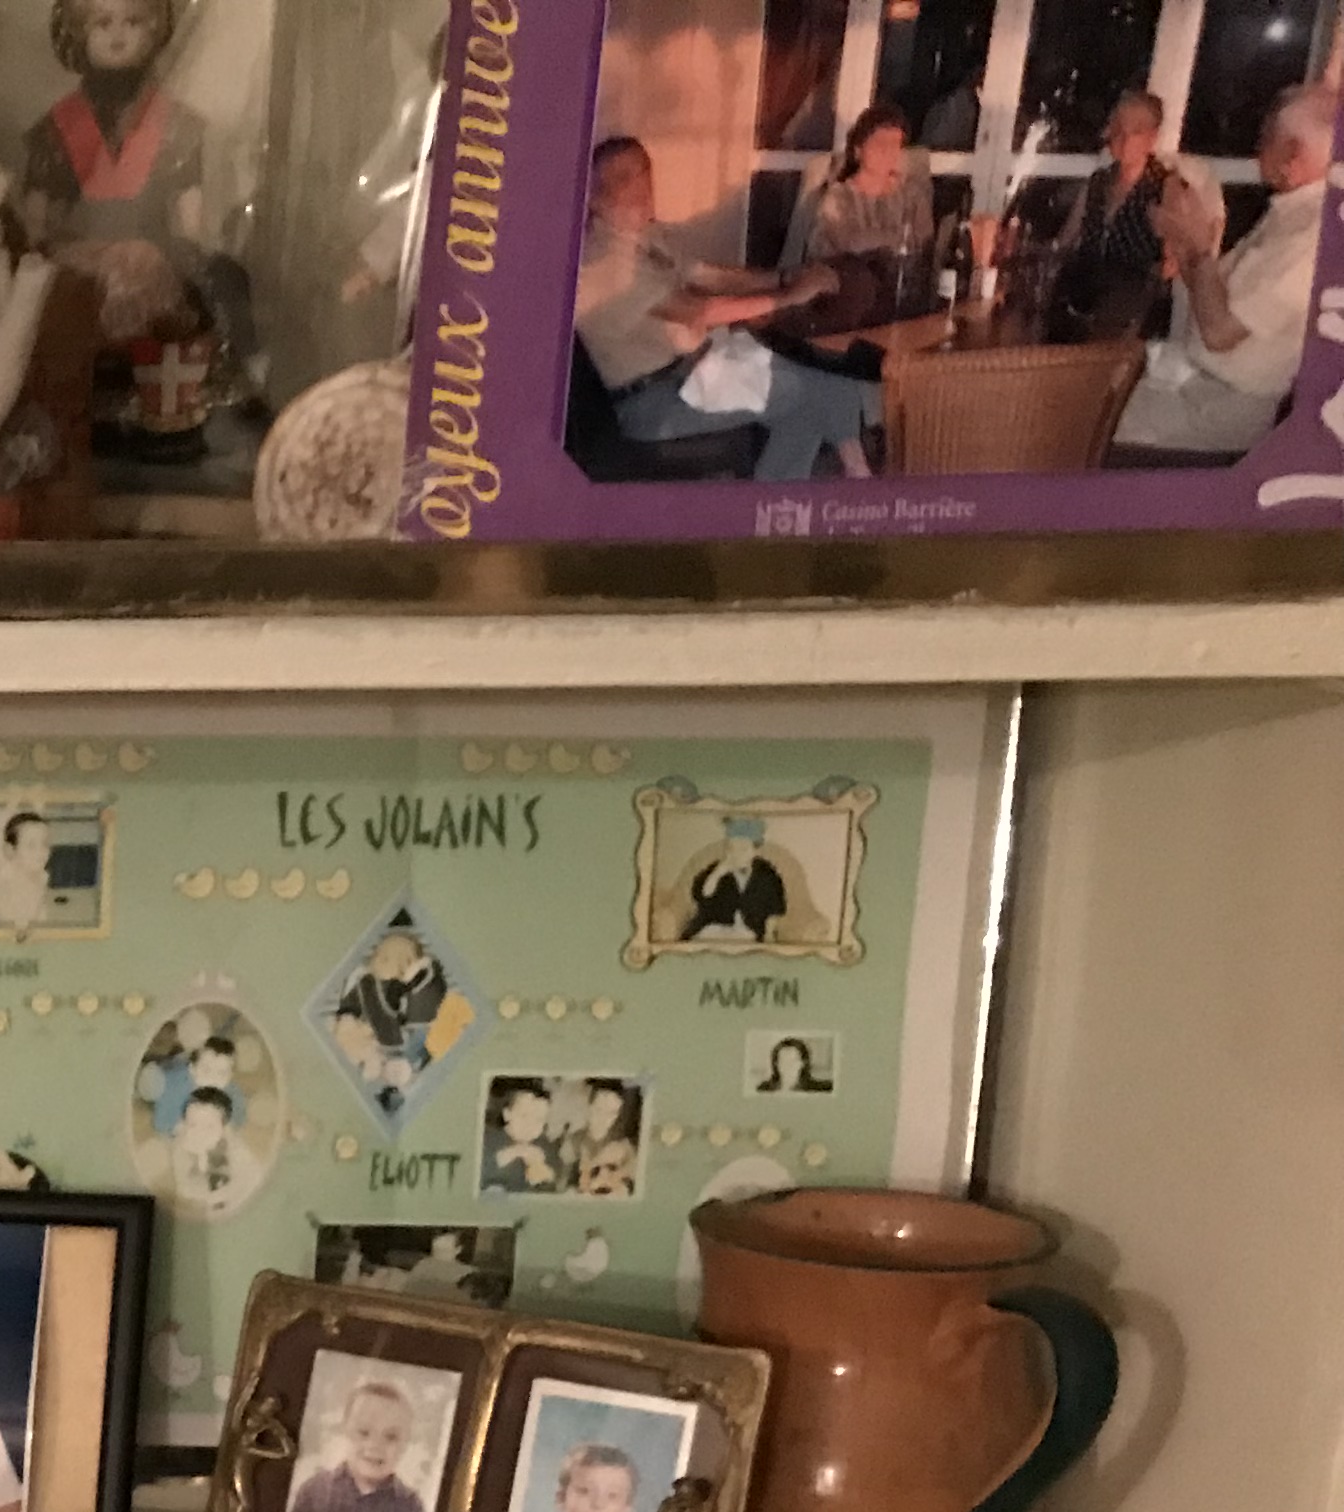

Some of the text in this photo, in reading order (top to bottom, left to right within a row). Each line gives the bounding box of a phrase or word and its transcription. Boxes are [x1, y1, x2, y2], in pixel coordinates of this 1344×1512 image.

[277, 791, 346, 849] LES
[698, 975, 799, 1010] MARTIN
[369, 1151, 462, 1192] ELIOTT
